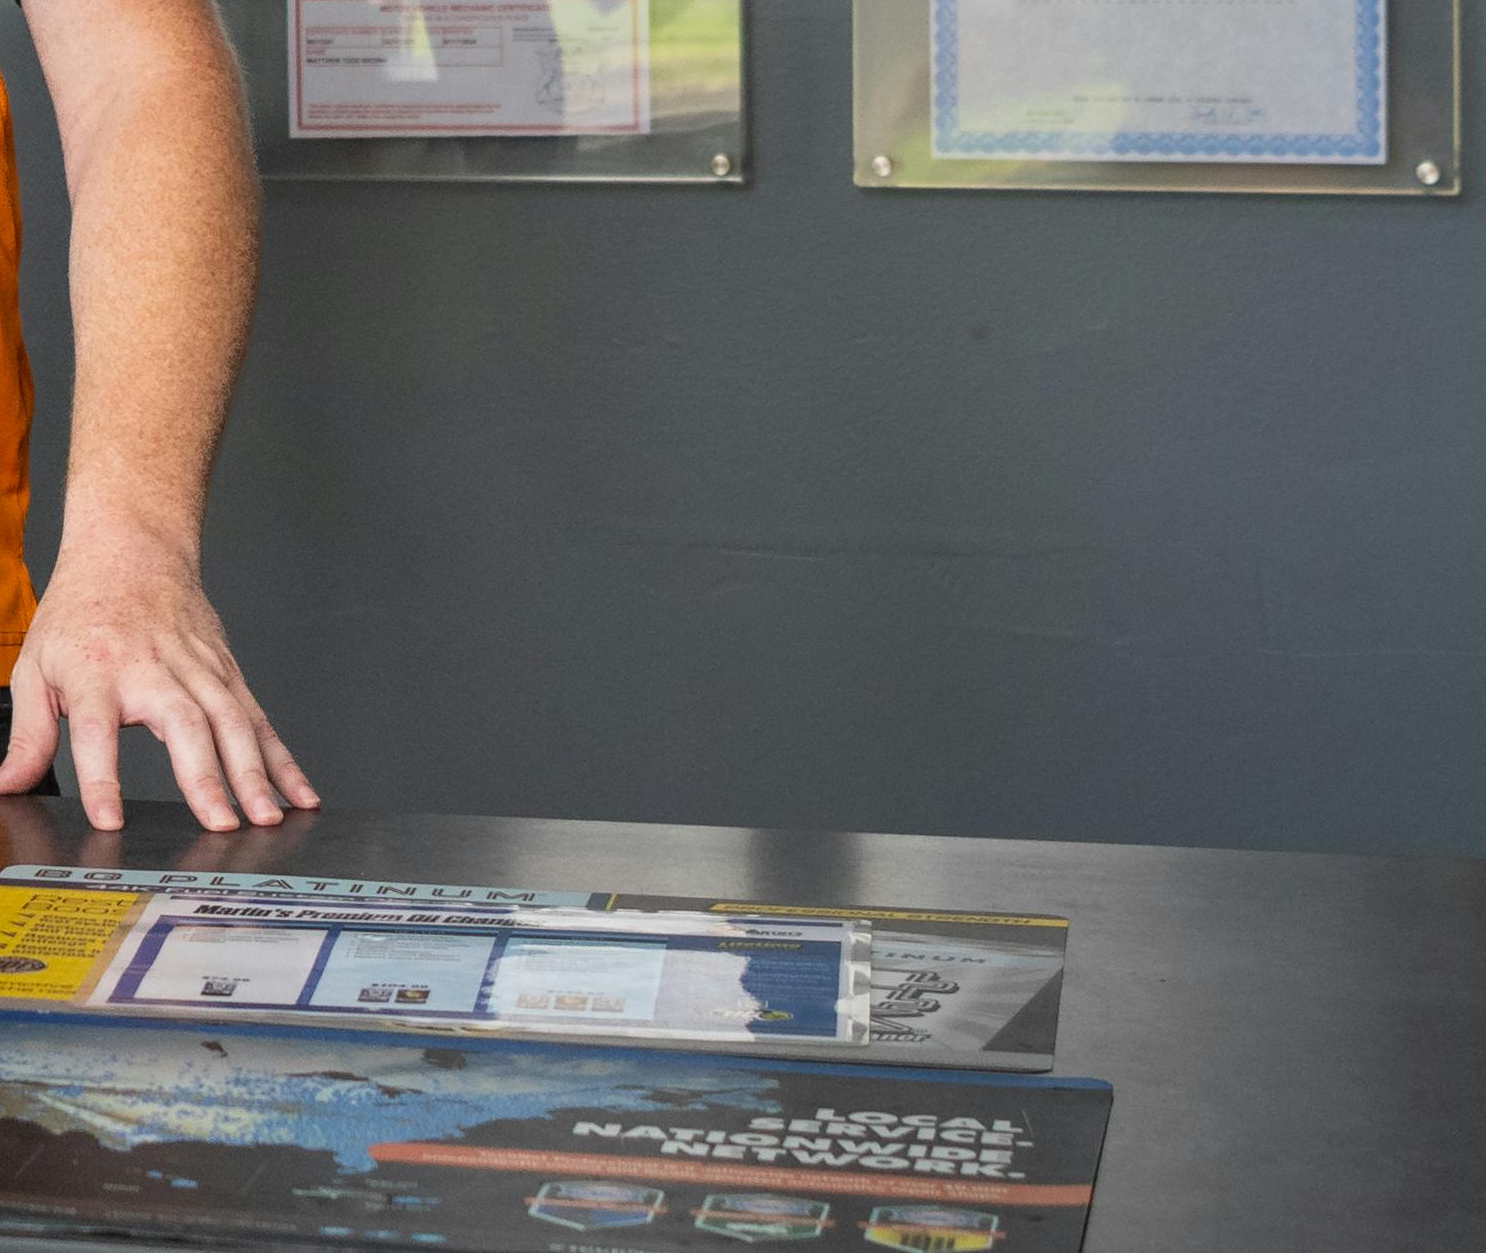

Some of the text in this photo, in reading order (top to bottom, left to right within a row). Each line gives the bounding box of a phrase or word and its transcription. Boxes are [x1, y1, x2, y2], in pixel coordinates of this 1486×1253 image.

[34, 868, 538, 902] BG PLATINUM
[193, 904, 439, 923] Martin's Premium Oil
[722, 905, 1033, 924] PROFESSIONAL STRENGTH
[747, 1116, 1035, 1147] SERVICE.
[815, 1108, 1023, 1133] LOCAL
[571, 1121, 1013, 1165] NATIONWIDE
[659, 1141, 1027, 1179] NETWORK.
